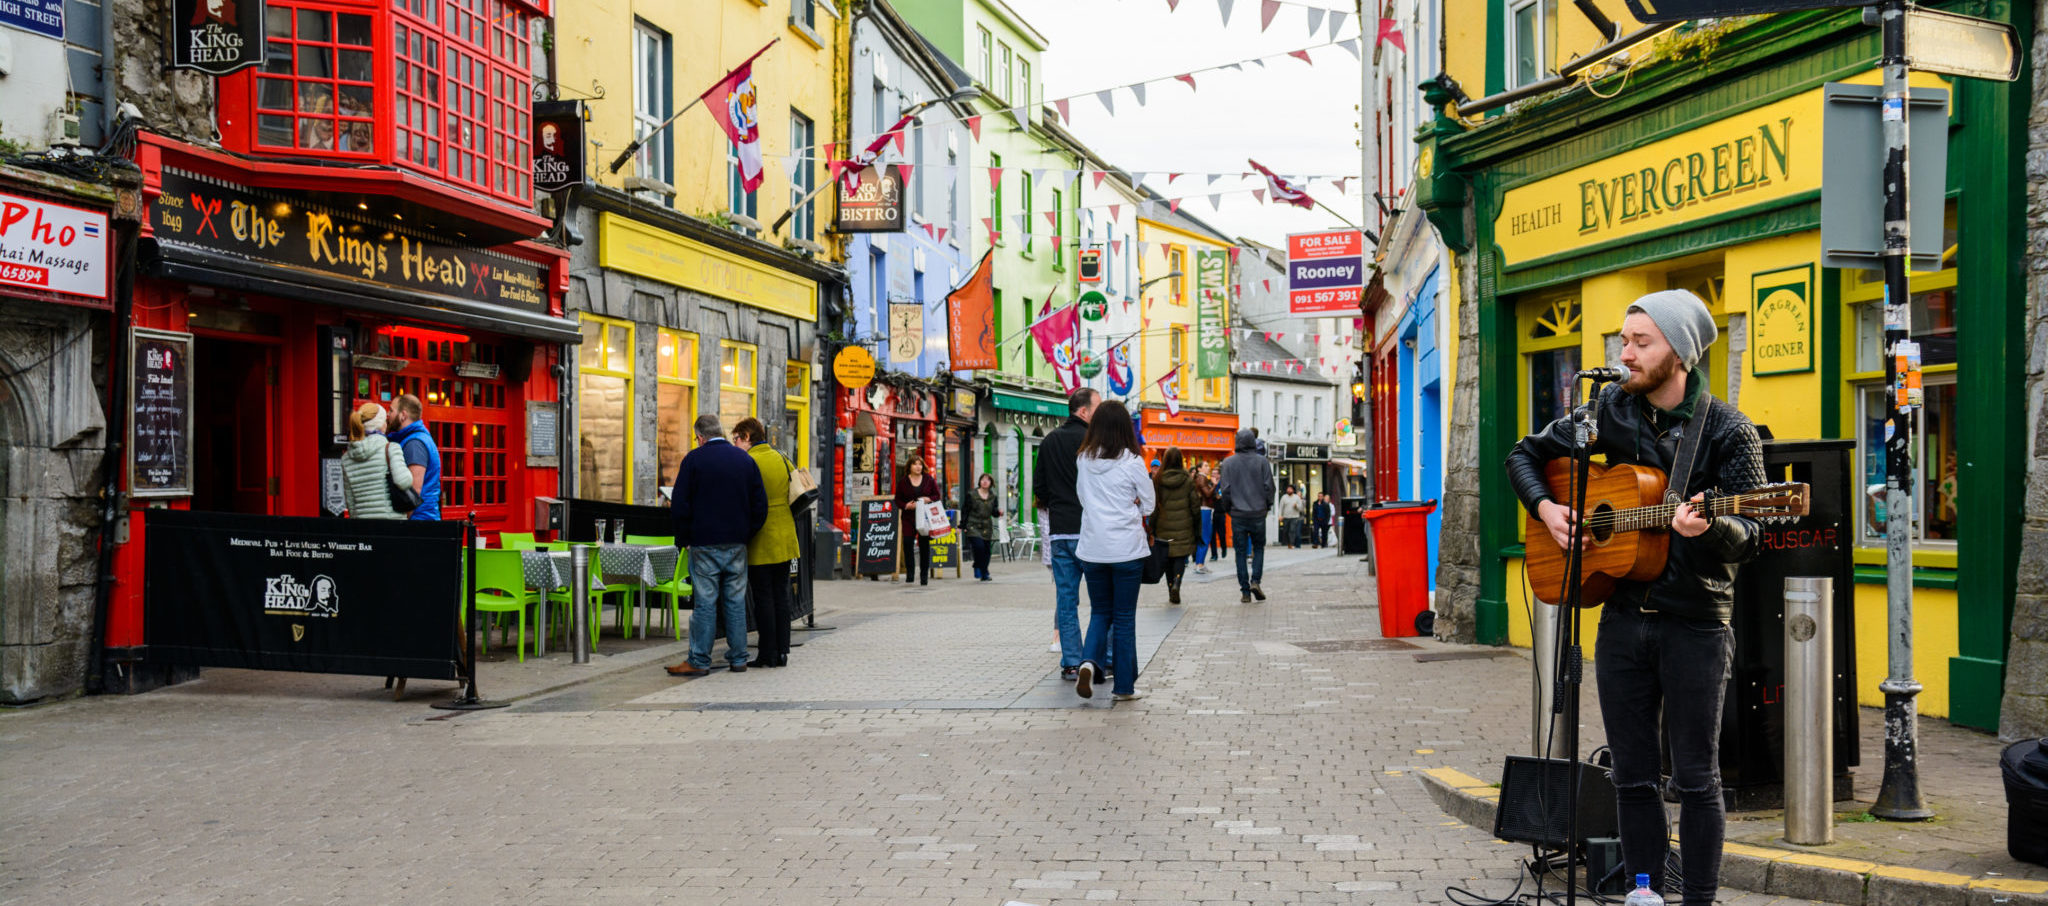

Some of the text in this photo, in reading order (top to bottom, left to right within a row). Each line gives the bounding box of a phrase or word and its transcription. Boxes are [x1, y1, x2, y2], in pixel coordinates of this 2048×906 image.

[24, 7, 60, 28] STREET
[206, 24, 223, 34] The
[190, 47, 239, 63] HEAD
[533, 171, 567, 182] HEAD
[1511, 116, 1794, 236] HEALTH EVERGREEN
[158, 191, 185, 208] Since
[162, 210, 183, 233] 1649
[841, 207, 898, 222] BISTRO
[0, 201, 76, 247] Pho
[231, 200, 467, 288] The Kings Head
[1300, 234, 1352, 248] FOR SALE
[0, 243, 90, 275] hai Massage
[0, 265, 42, 283] 65894
[1297, 265, 1356, 280] Rooney
[1200, 257, 1225, 349] SWEATERS
[1295, 290, 1358, 304] 091 567 391
[1758, 300, 1806, 338] EVERGREEN
[1759, 341, 1805, 359] CORNER
[956, 359, 993, 367] MUSIC
[1297, 446, 1318, 457] CHOICE
[869, 523, 892, 532] Food
[864, 531, 895, 542] Served
[281, 574, 295, 584] The
[264, 595, 305, 609] HEAD
